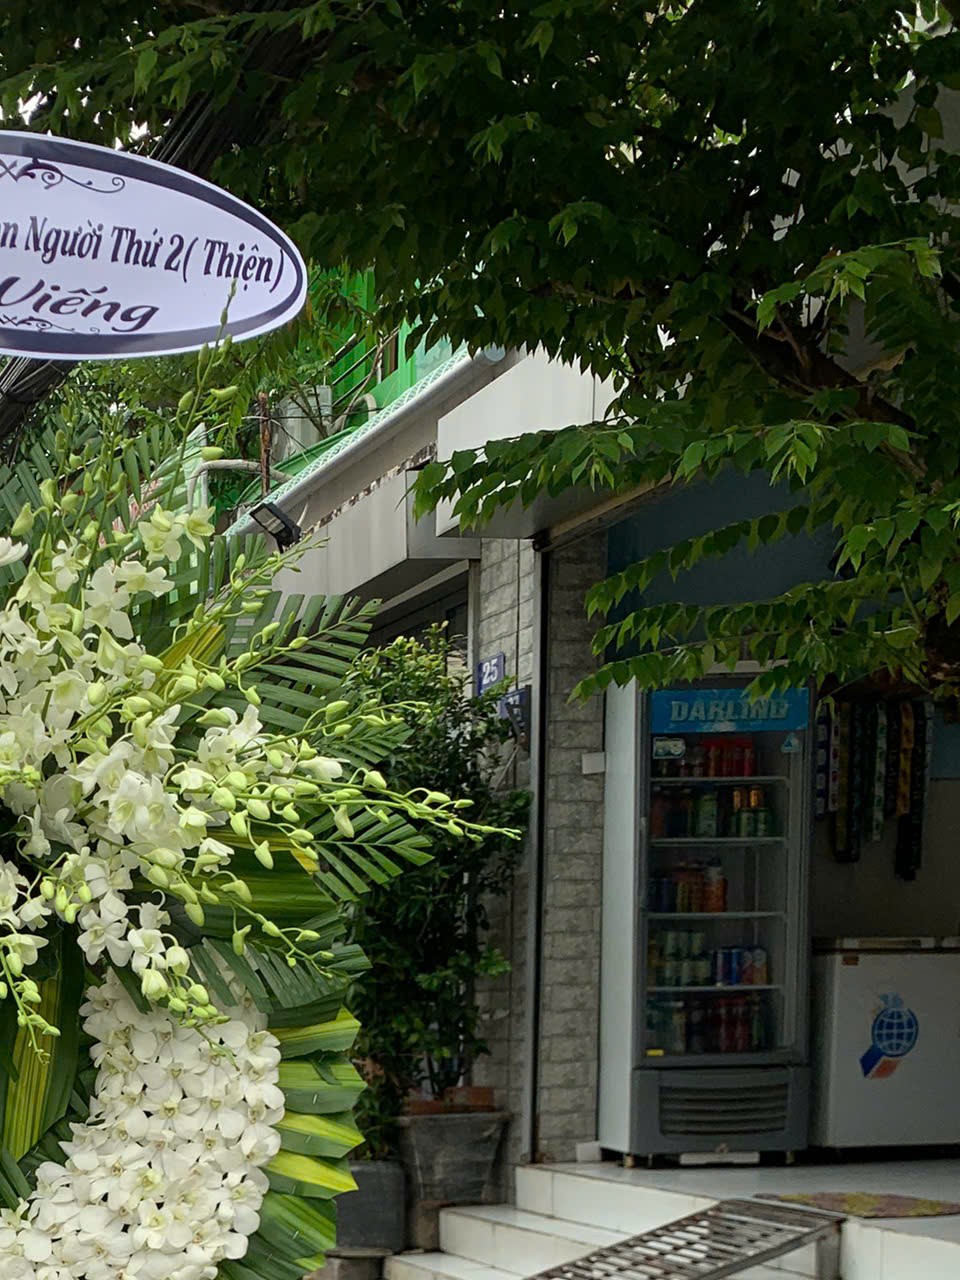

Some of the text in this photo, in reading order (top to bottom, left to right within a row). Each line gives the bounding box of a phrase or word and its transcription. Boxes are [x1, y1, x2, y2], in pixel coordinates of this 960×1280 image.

[24, 216, 104, 264] Người
[111, 225, 164, 268] Thứ
[482, 658, 499, 685] 25
[671, 699, 789, 721] DARLING
